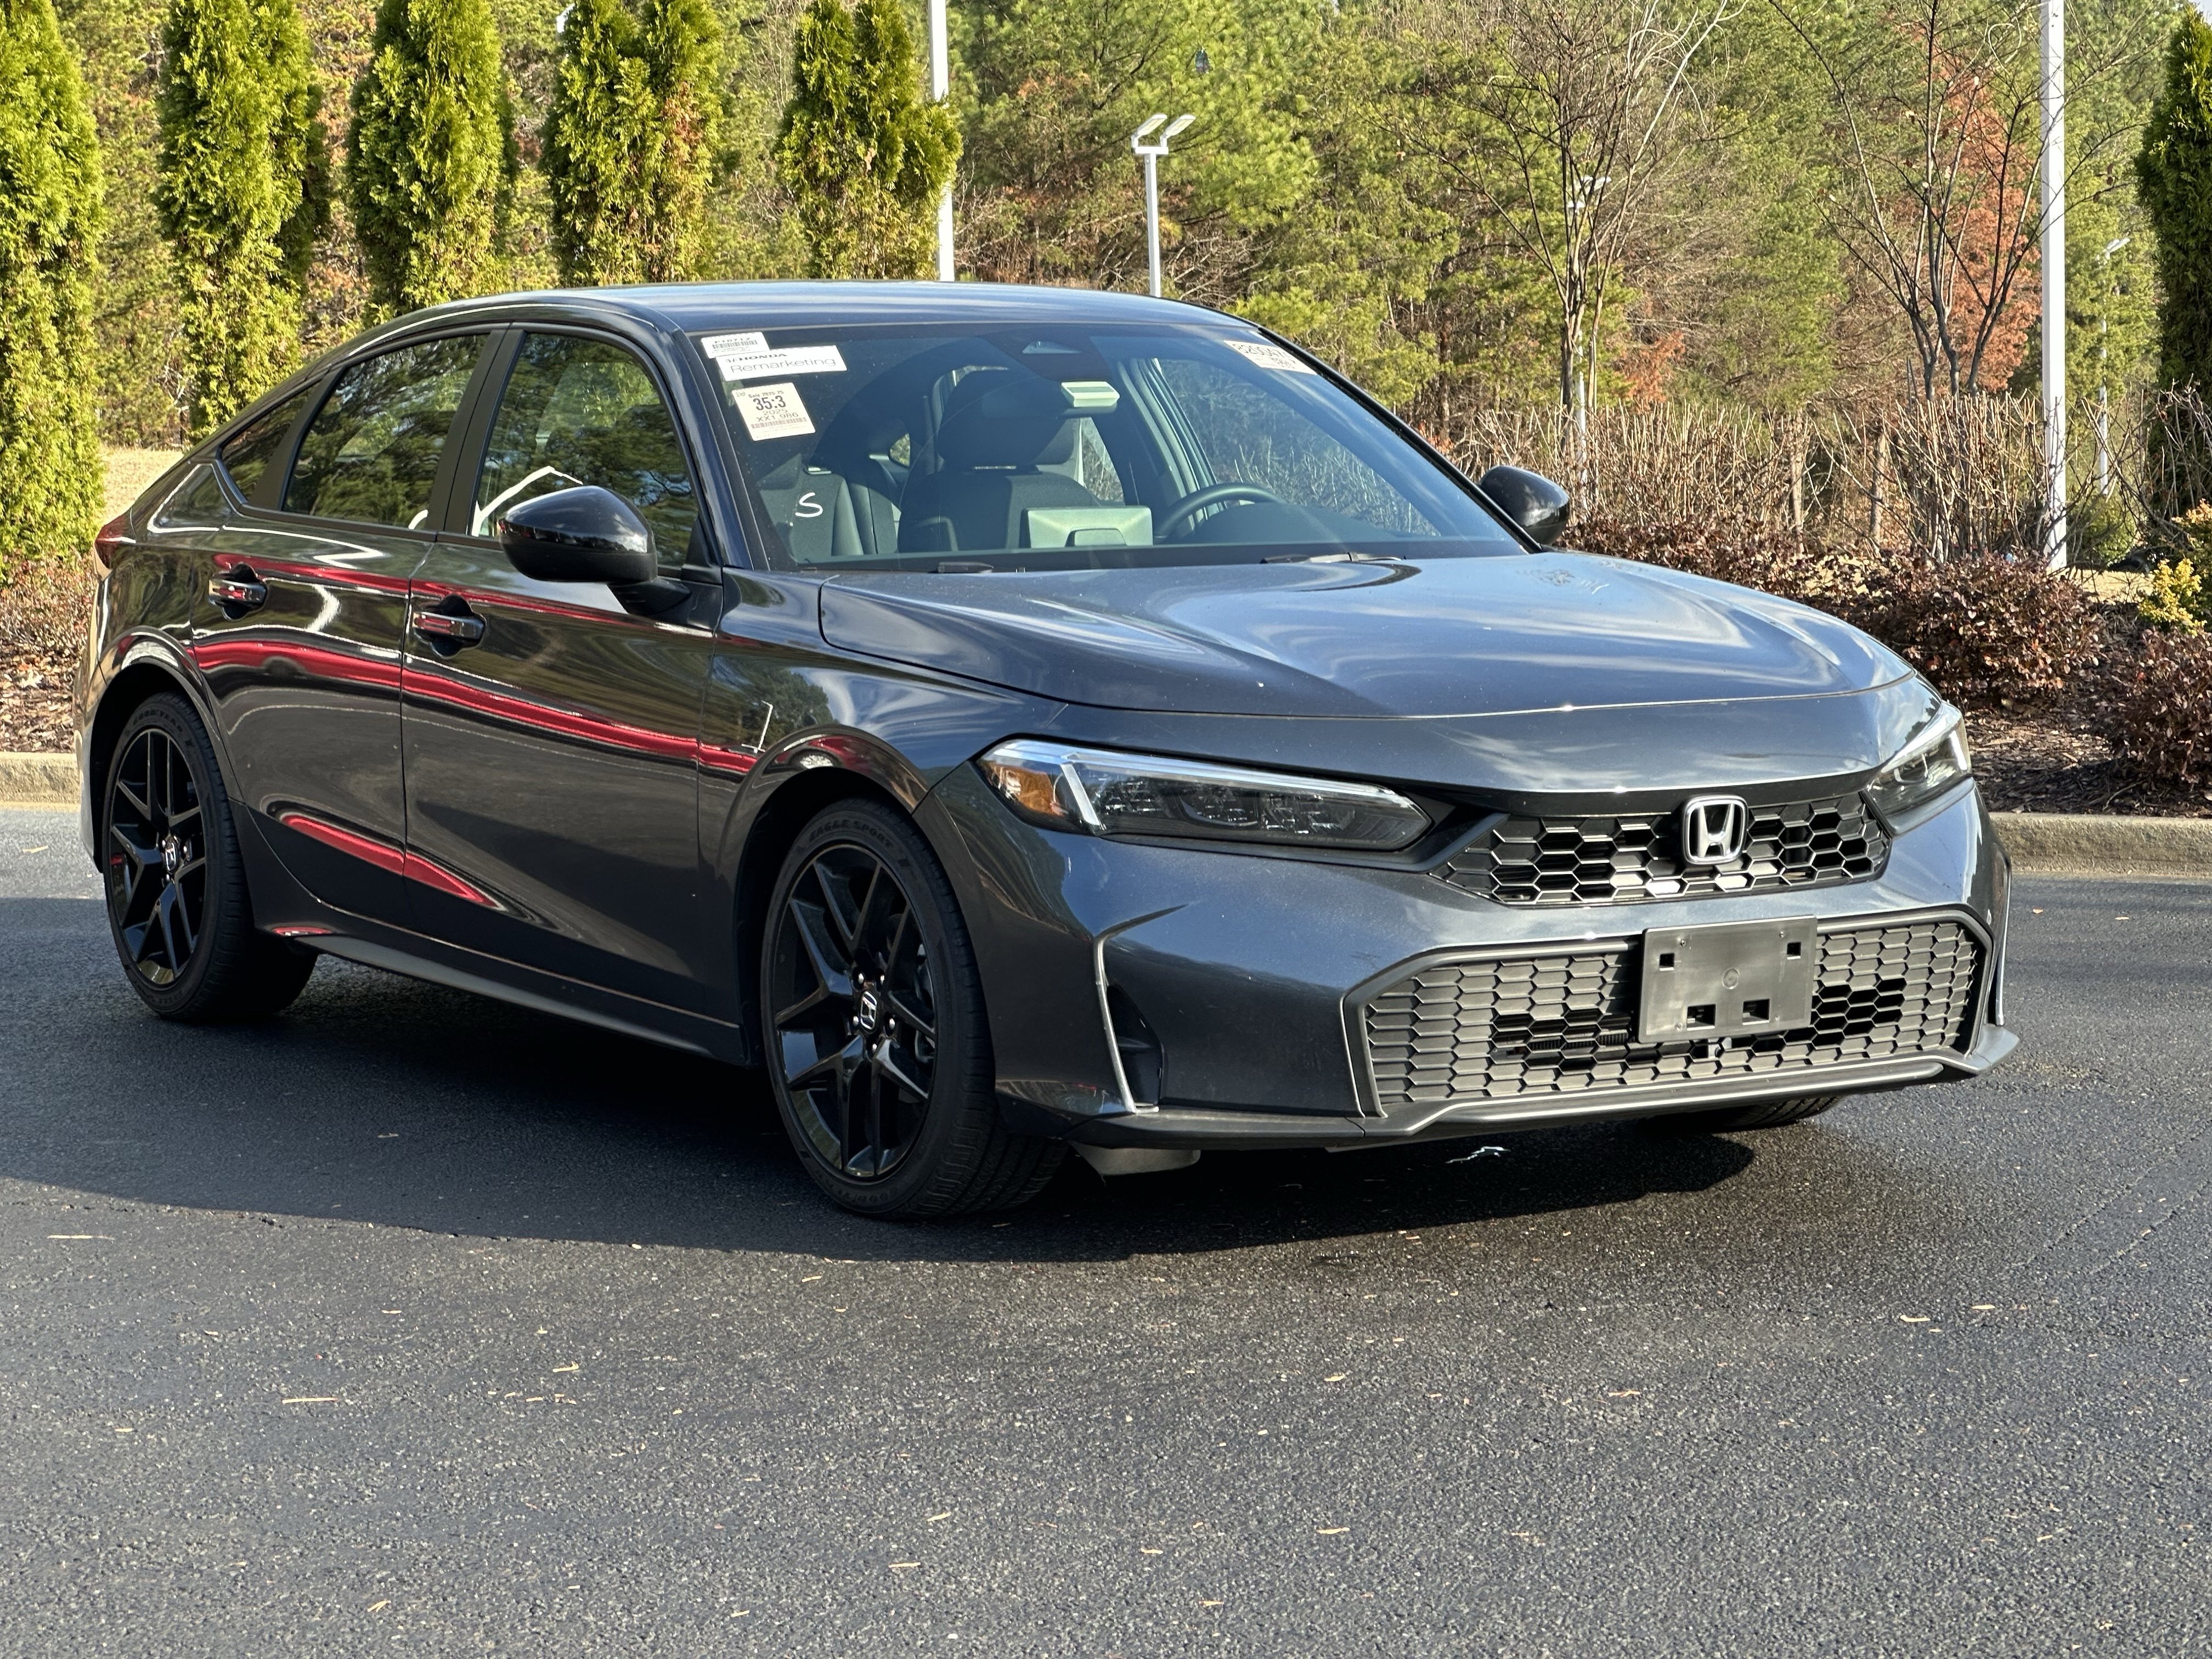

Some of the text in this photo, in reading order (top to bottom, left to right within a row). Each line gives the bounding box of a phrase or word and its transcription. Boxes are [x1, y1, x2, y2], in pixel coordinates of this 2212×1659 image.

[731, 358, 836, 373] Remarketing
[753, 395, 786, 411] 35:3
[795, 492, 823, 518] S
[810, 820, 894, 848] EAGLE SPORT
